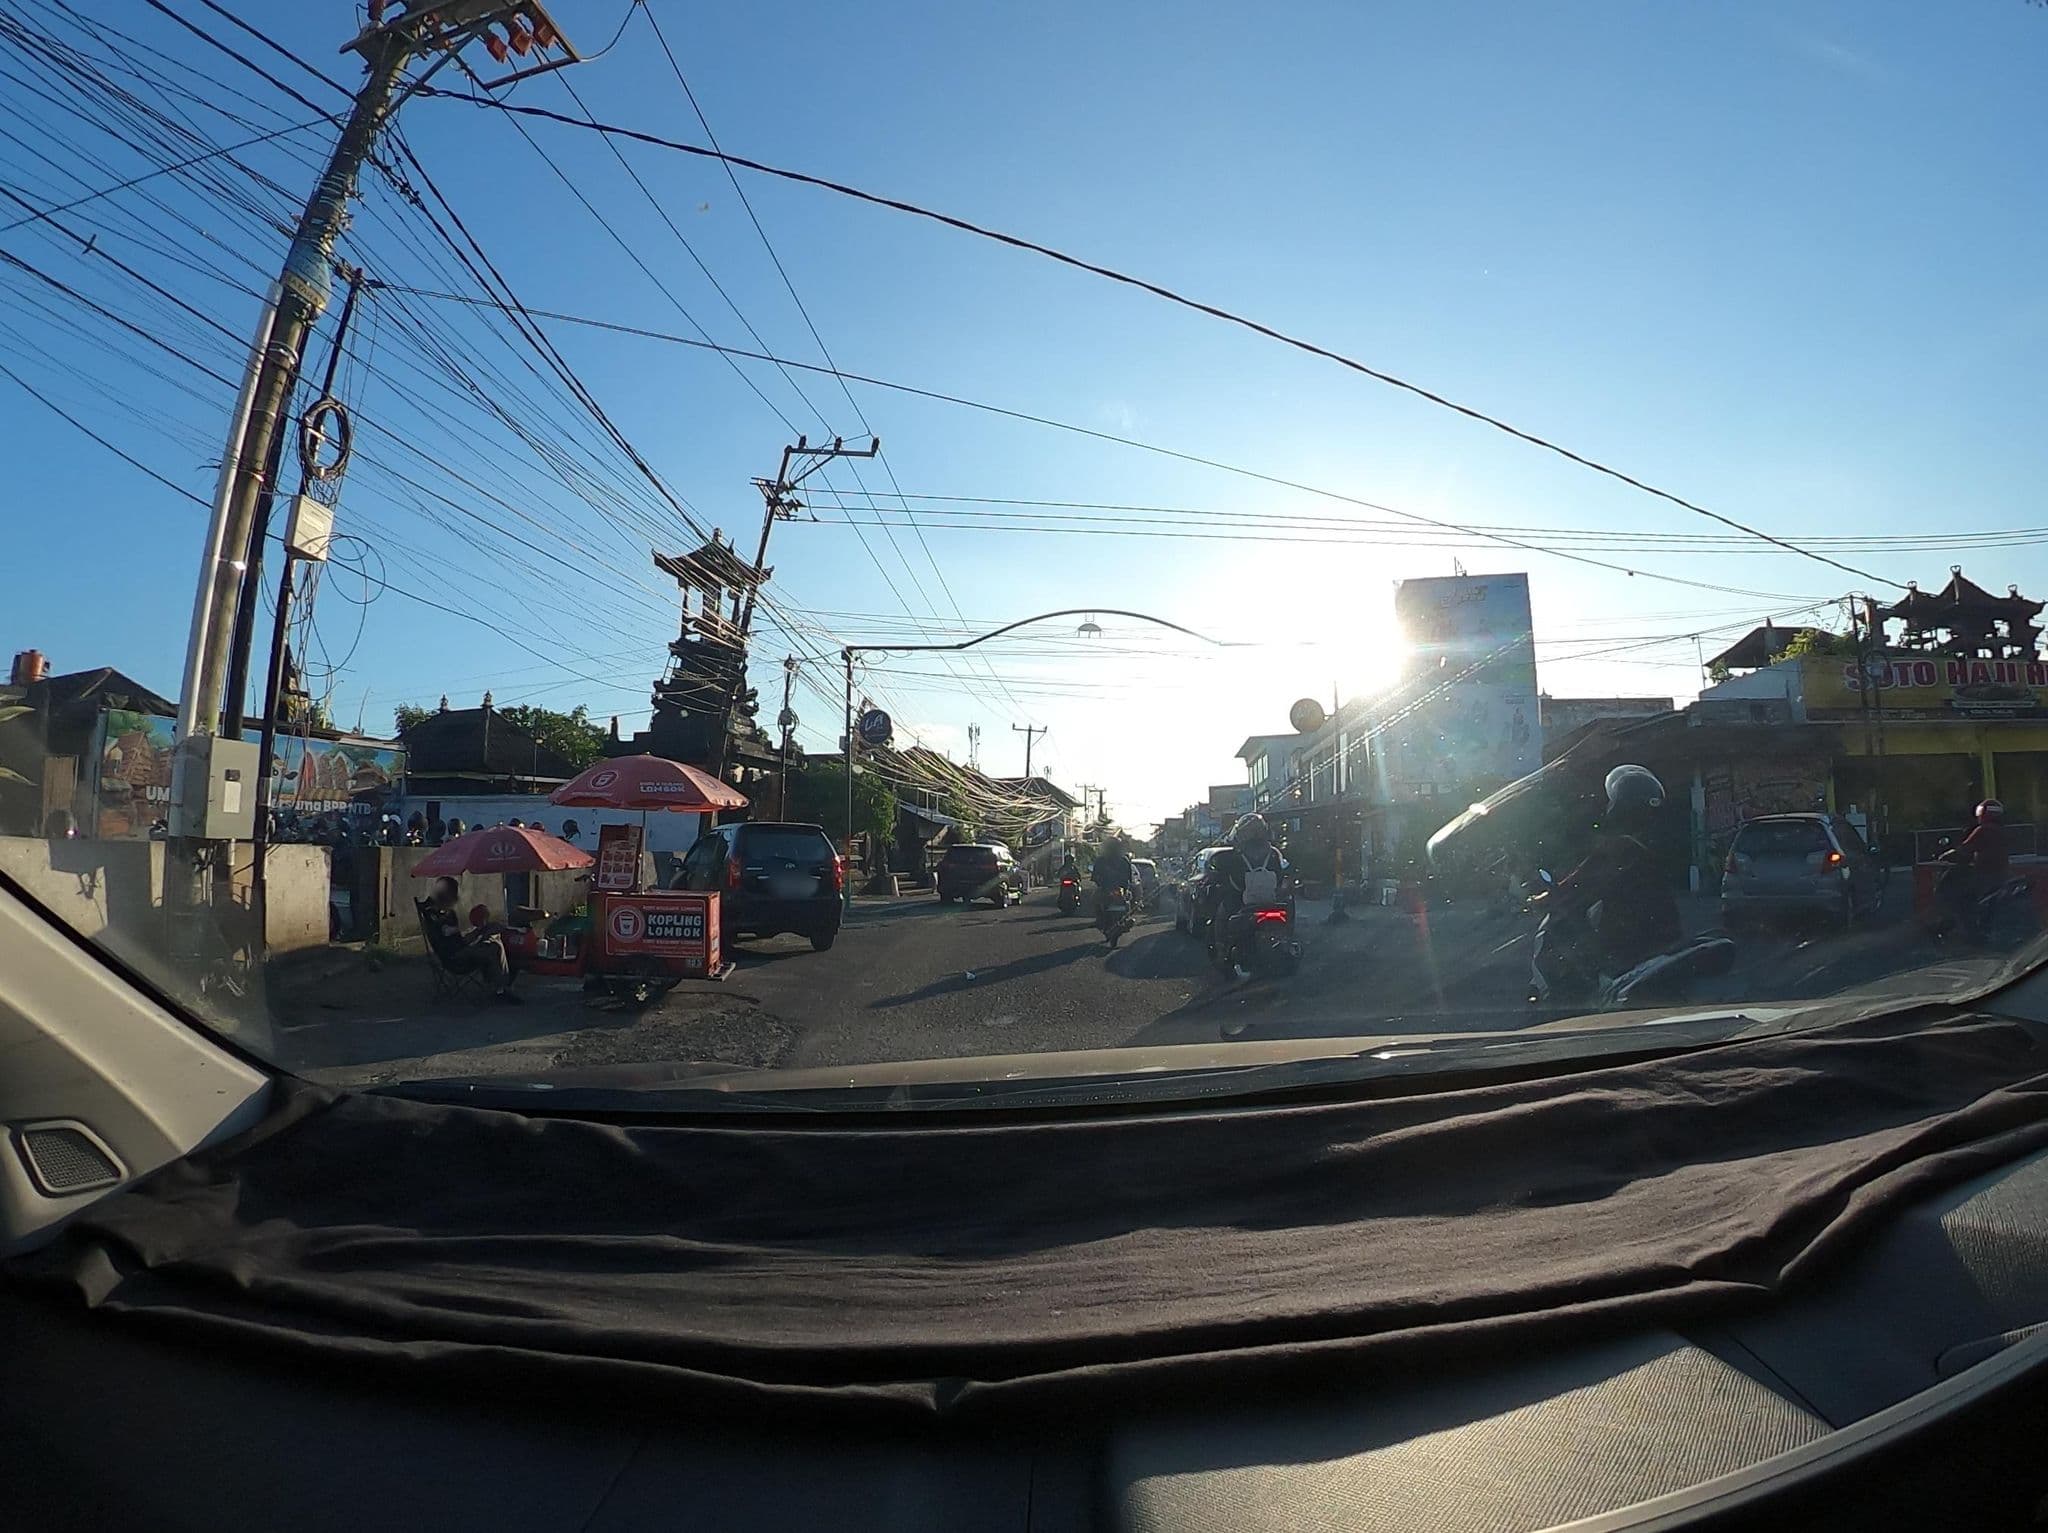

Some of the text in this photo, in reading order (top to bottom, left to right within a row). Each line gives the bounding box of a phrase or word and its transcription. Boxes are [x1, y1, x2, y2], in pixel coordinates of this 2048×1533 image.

[1843, 660, 1938, 690] SOTO
[1946, 661, 2018, 686] HAJI
[647, 914, 702, 926] KOPLING
[647, 926, 701, 937] LOMBOK
